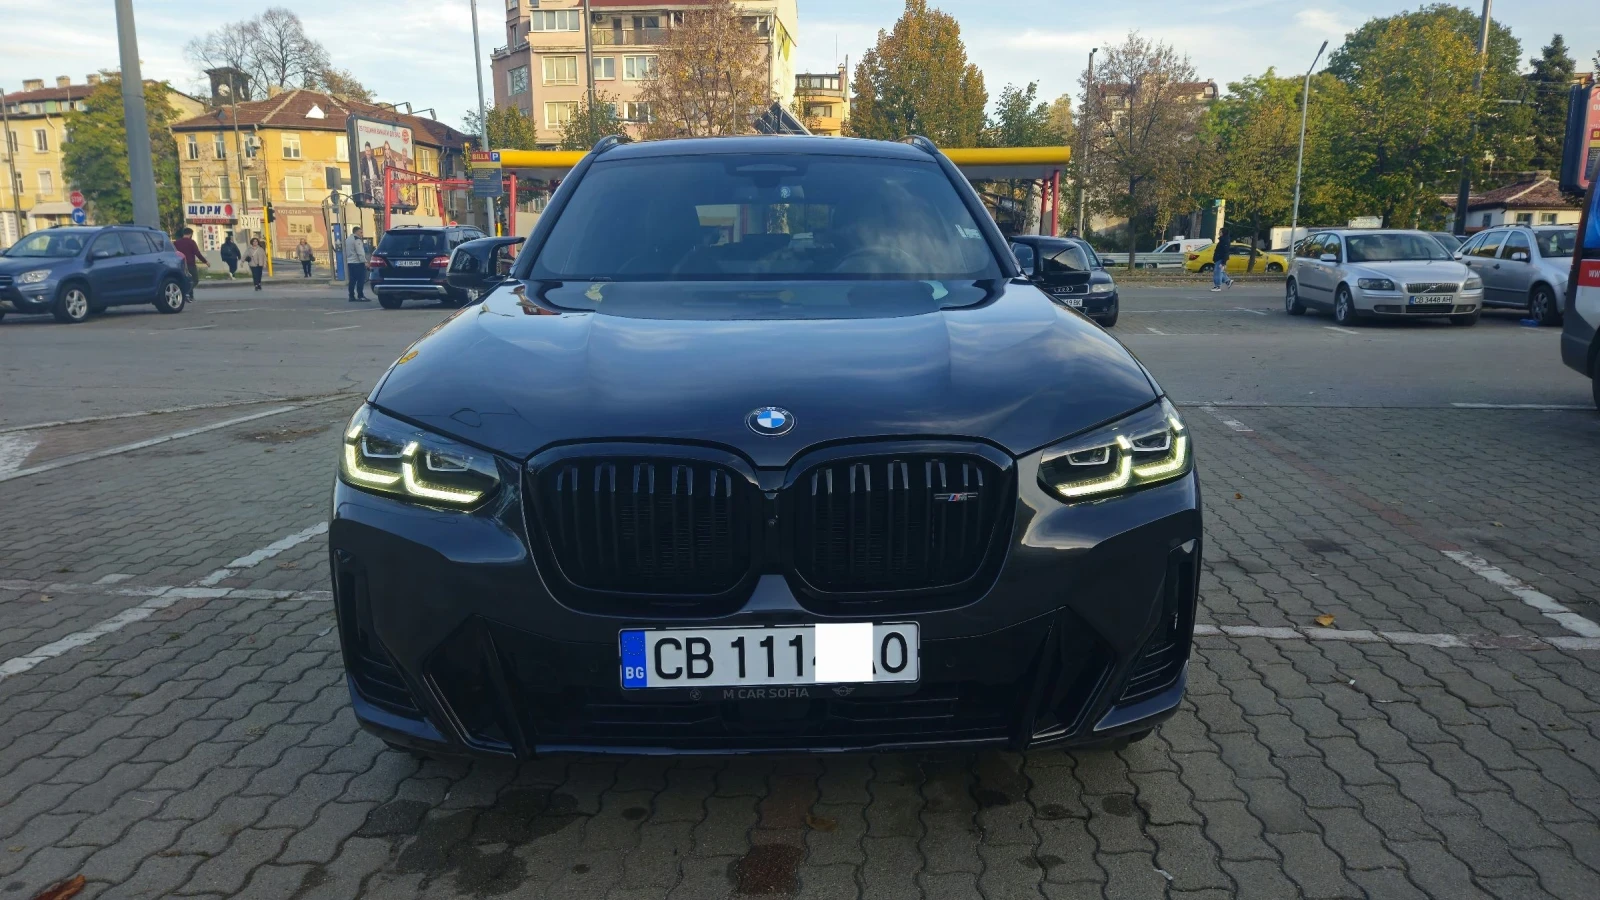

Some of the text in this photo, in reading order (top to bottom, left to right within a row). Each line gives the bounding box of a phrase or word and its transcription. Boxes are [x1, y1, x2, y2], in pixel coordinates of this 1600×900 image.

[188, 205, 221, 215] ЩОРИ
[653, 636, 714, 680] CB
[731, 634, 816, 678] 111
[625, 667, 644, 679] BG
[723, 687, 810, 699] M CAR SOFIA
